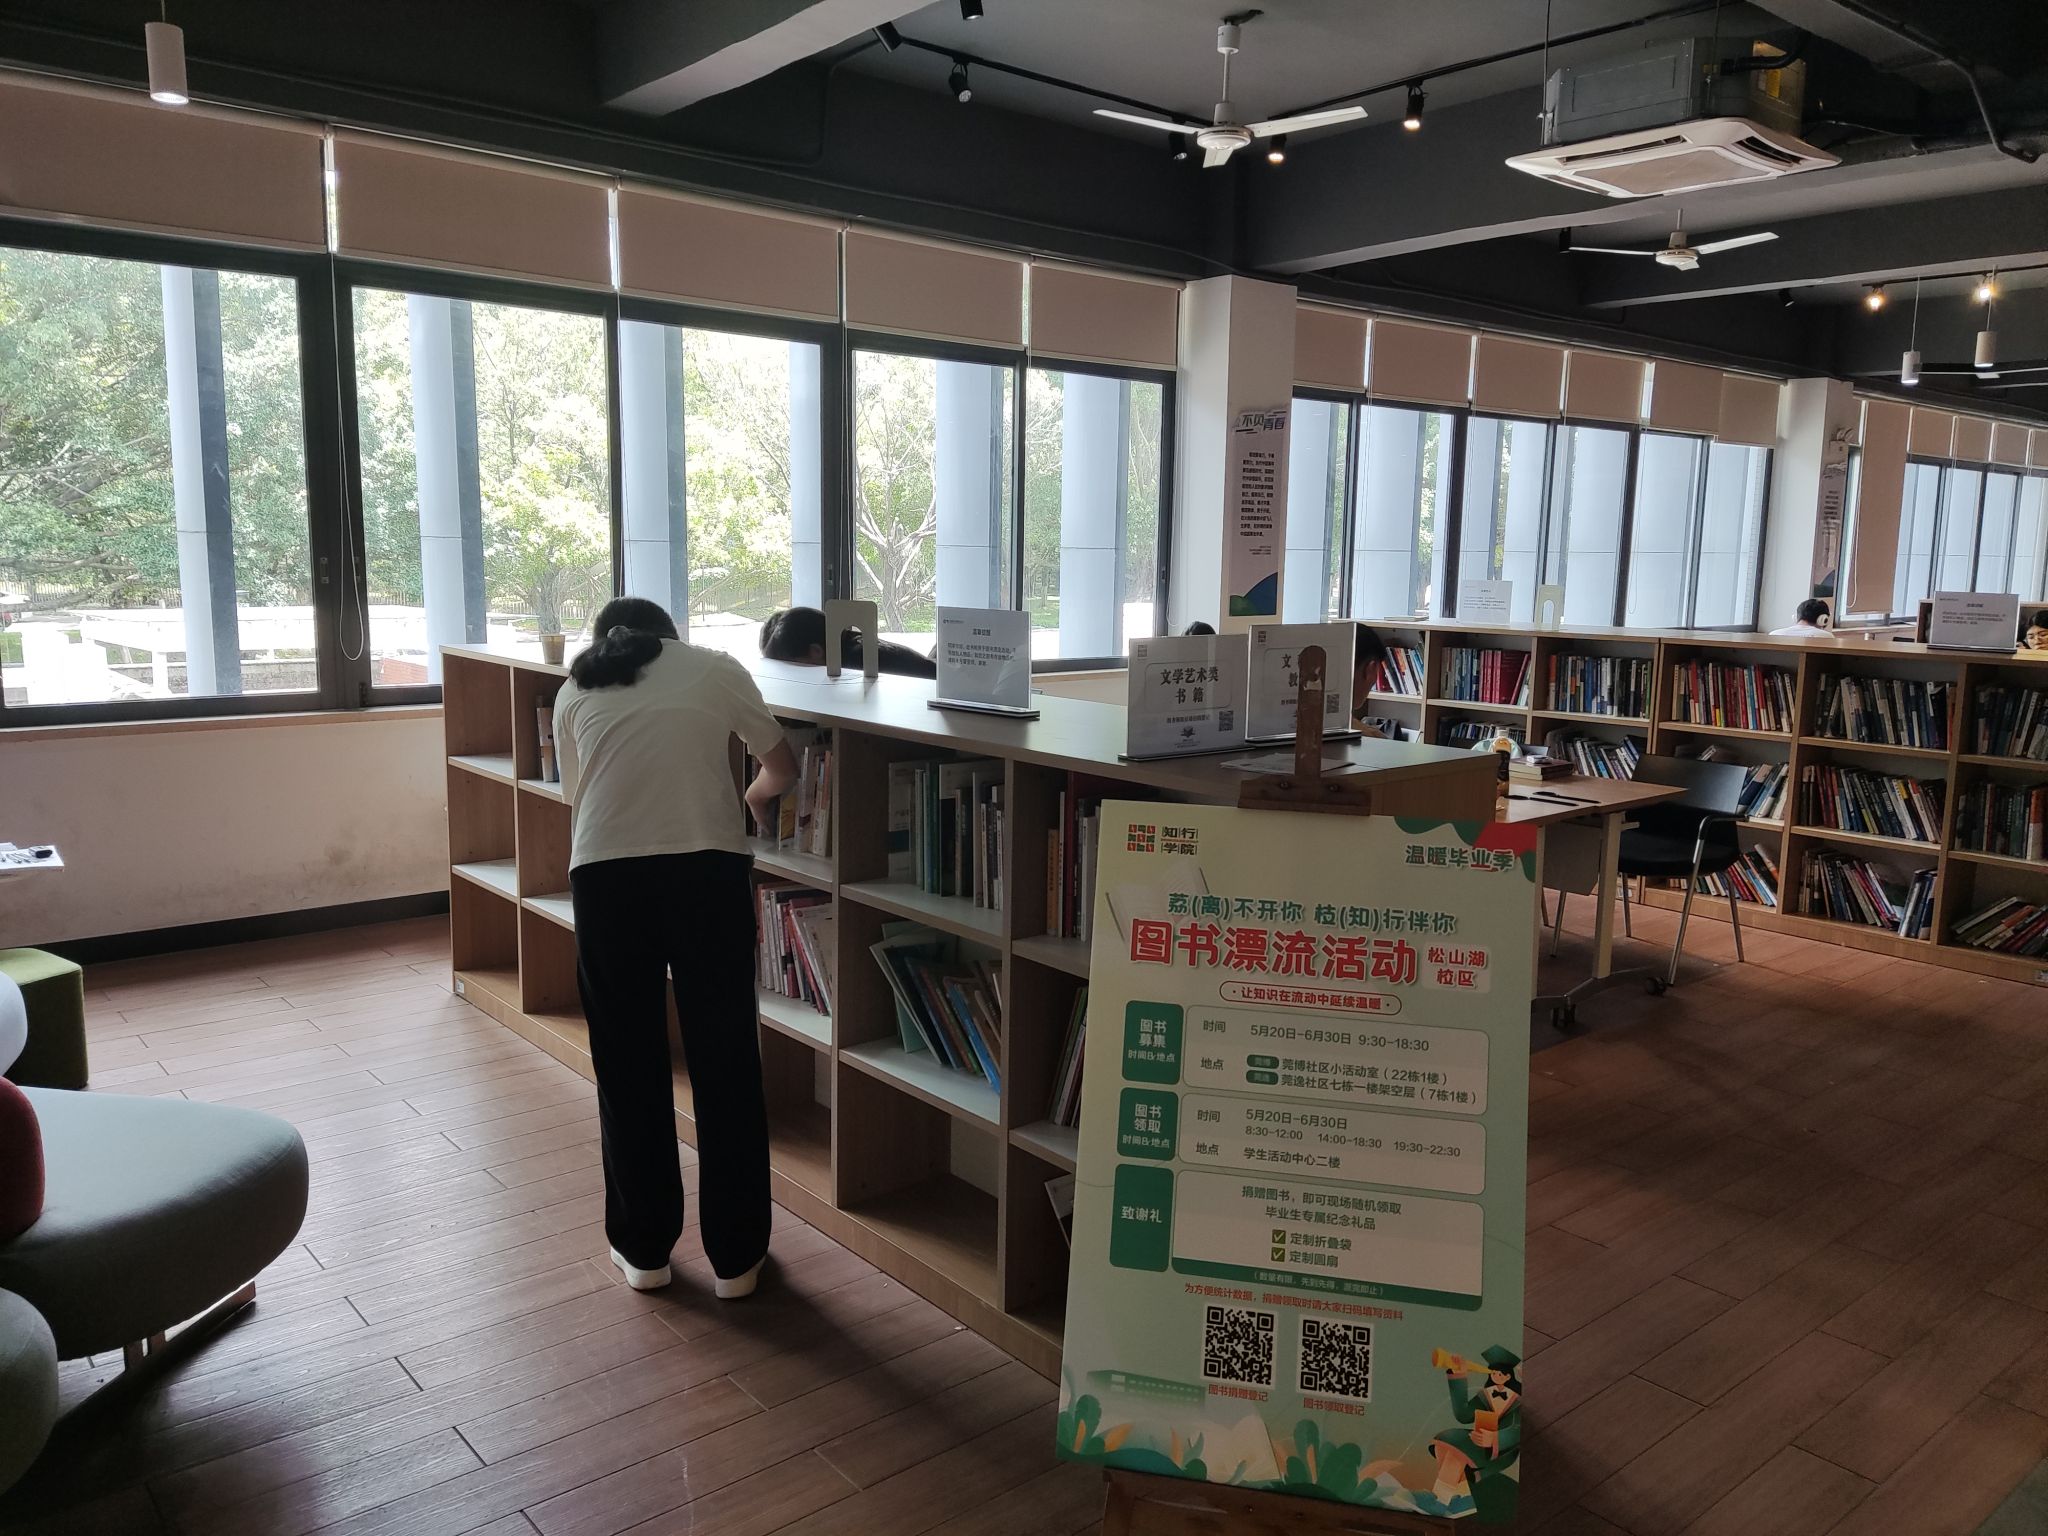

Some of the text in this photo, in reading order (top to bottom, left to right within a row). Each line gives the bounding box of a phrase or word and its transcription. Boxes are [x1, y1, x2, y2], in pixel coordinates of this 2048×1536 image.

[1160, 666, 1219, 685] 文学艺术类
[1175, 687, 1204, 704] 书籍
[1162, 825, 1197, 840] 知行
[1162, 842, 1197, 856] 学院
[1405, 844, 1515, 872] 温暖毕业季
[1168, 893, 1457, 934] 荔(离)不开你 枝(知)行伴你
[1130, 918, 1417, 986] 图书漂流活动
[1427, 946, 1487, 967] 松山湖
[1437, 968, 1476, 988] 校区
[1140, 1019, 1167, 1034] 图书
[1203, 1019, 1226, 1034] 时间
[1139, 1033, 1166, 1049] 募集
[1358, 1034, 1429, 1052] 9:30-18:30
[1128, 1049, 1176, 1063] 时间&地点
[1200, 1057, 1224, 1072] 地点
[1135, 1103, 1162, 1119] 图书
[1197, 1109, 1221, 1123] 时间
[1134, 1118, 1161, 1134] 领取
[1122, 1134, 1170, 1149] 时间&地点
[1196, 1142, 1219, 1157] 地点
[1245, 1125, 1461, 1157] 8:30-12:00 14:00-18:30 19:30-22:30
[1244, 1146, 1341, 1169] 学生活动中心二楼
[1120, 1205, 1162, 1224] 致谢礼
[1265, 1205, 1376, 1231] 毕业生专属纪念礼品
[1290, 1232, 1352, 1251] 定制折叠袋
[1289, 1250, 1339, 1267] 定制圆扇
[1207, 1384, 1268, 1402] 图书捐赠登记
[1303, 1397, 1365, 1416] 图书领取登记
